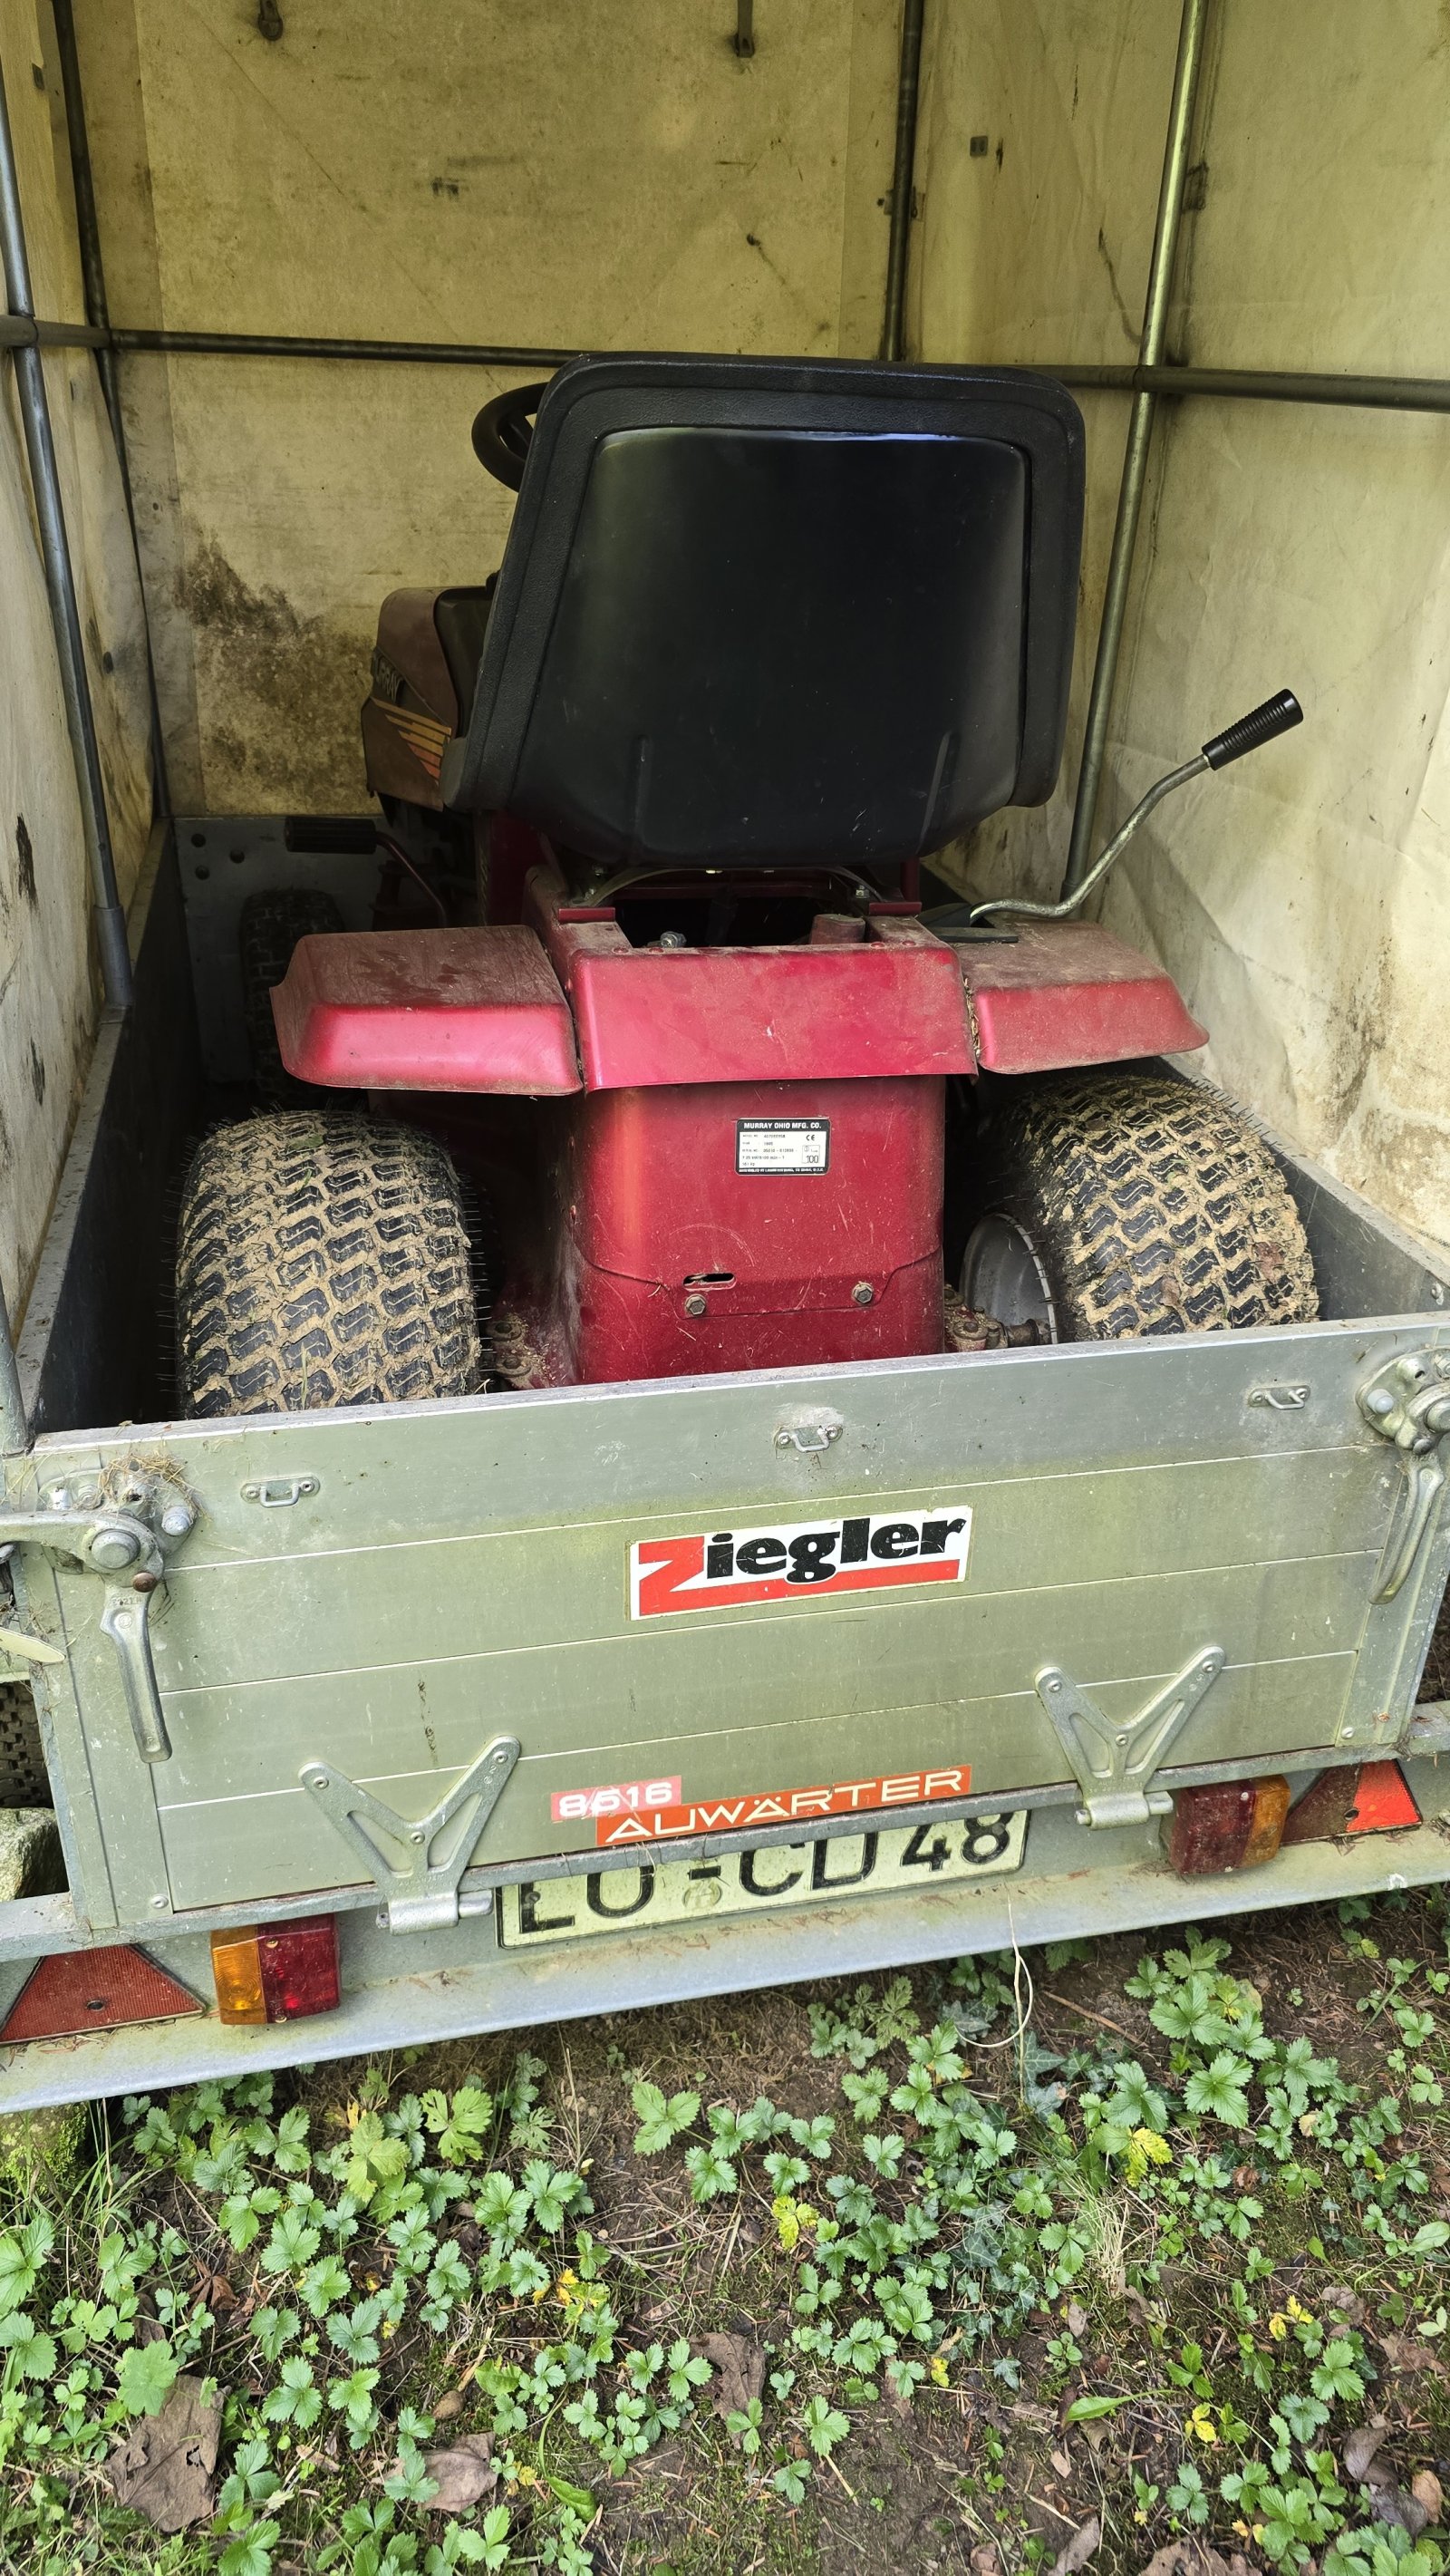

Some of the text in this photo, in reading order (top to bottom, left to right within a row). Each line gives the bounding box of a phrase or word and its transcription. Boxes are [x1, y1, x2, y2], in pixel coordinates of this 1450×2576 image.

[806, 1155, 819, 1164] 100
[638, 1516, 966, 1617] Ziegler
[558, 1781, 672, 1817] 8516
[604, 1769, 962, 1843] AUWÄRTER
